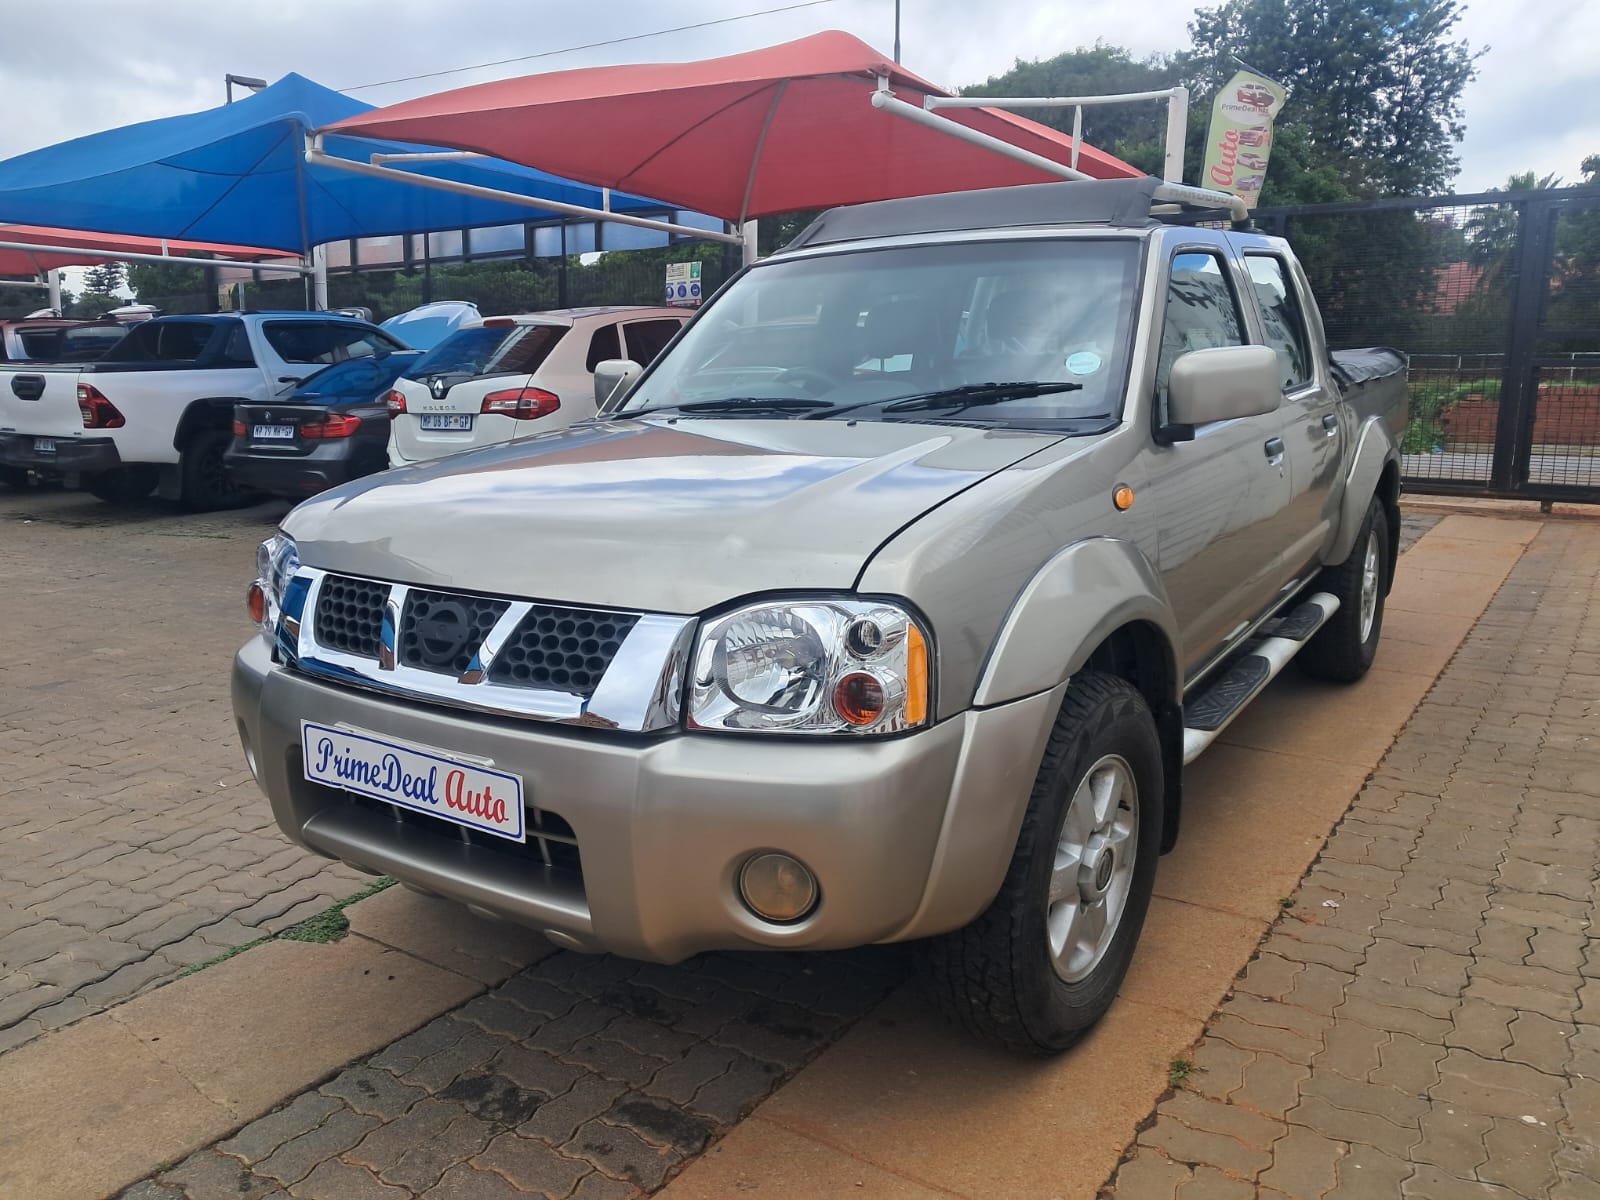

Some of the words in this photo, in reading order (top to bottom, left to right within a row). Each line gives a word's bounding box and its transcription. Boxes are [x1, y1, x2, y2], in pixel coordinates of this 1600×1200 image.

[1211, 129, 1239, 187] Auto
[459, 415, 469, 429] GP
[315, 737, 439, 805] PrimeDeal
[445, 769, 509, 824] Auto
